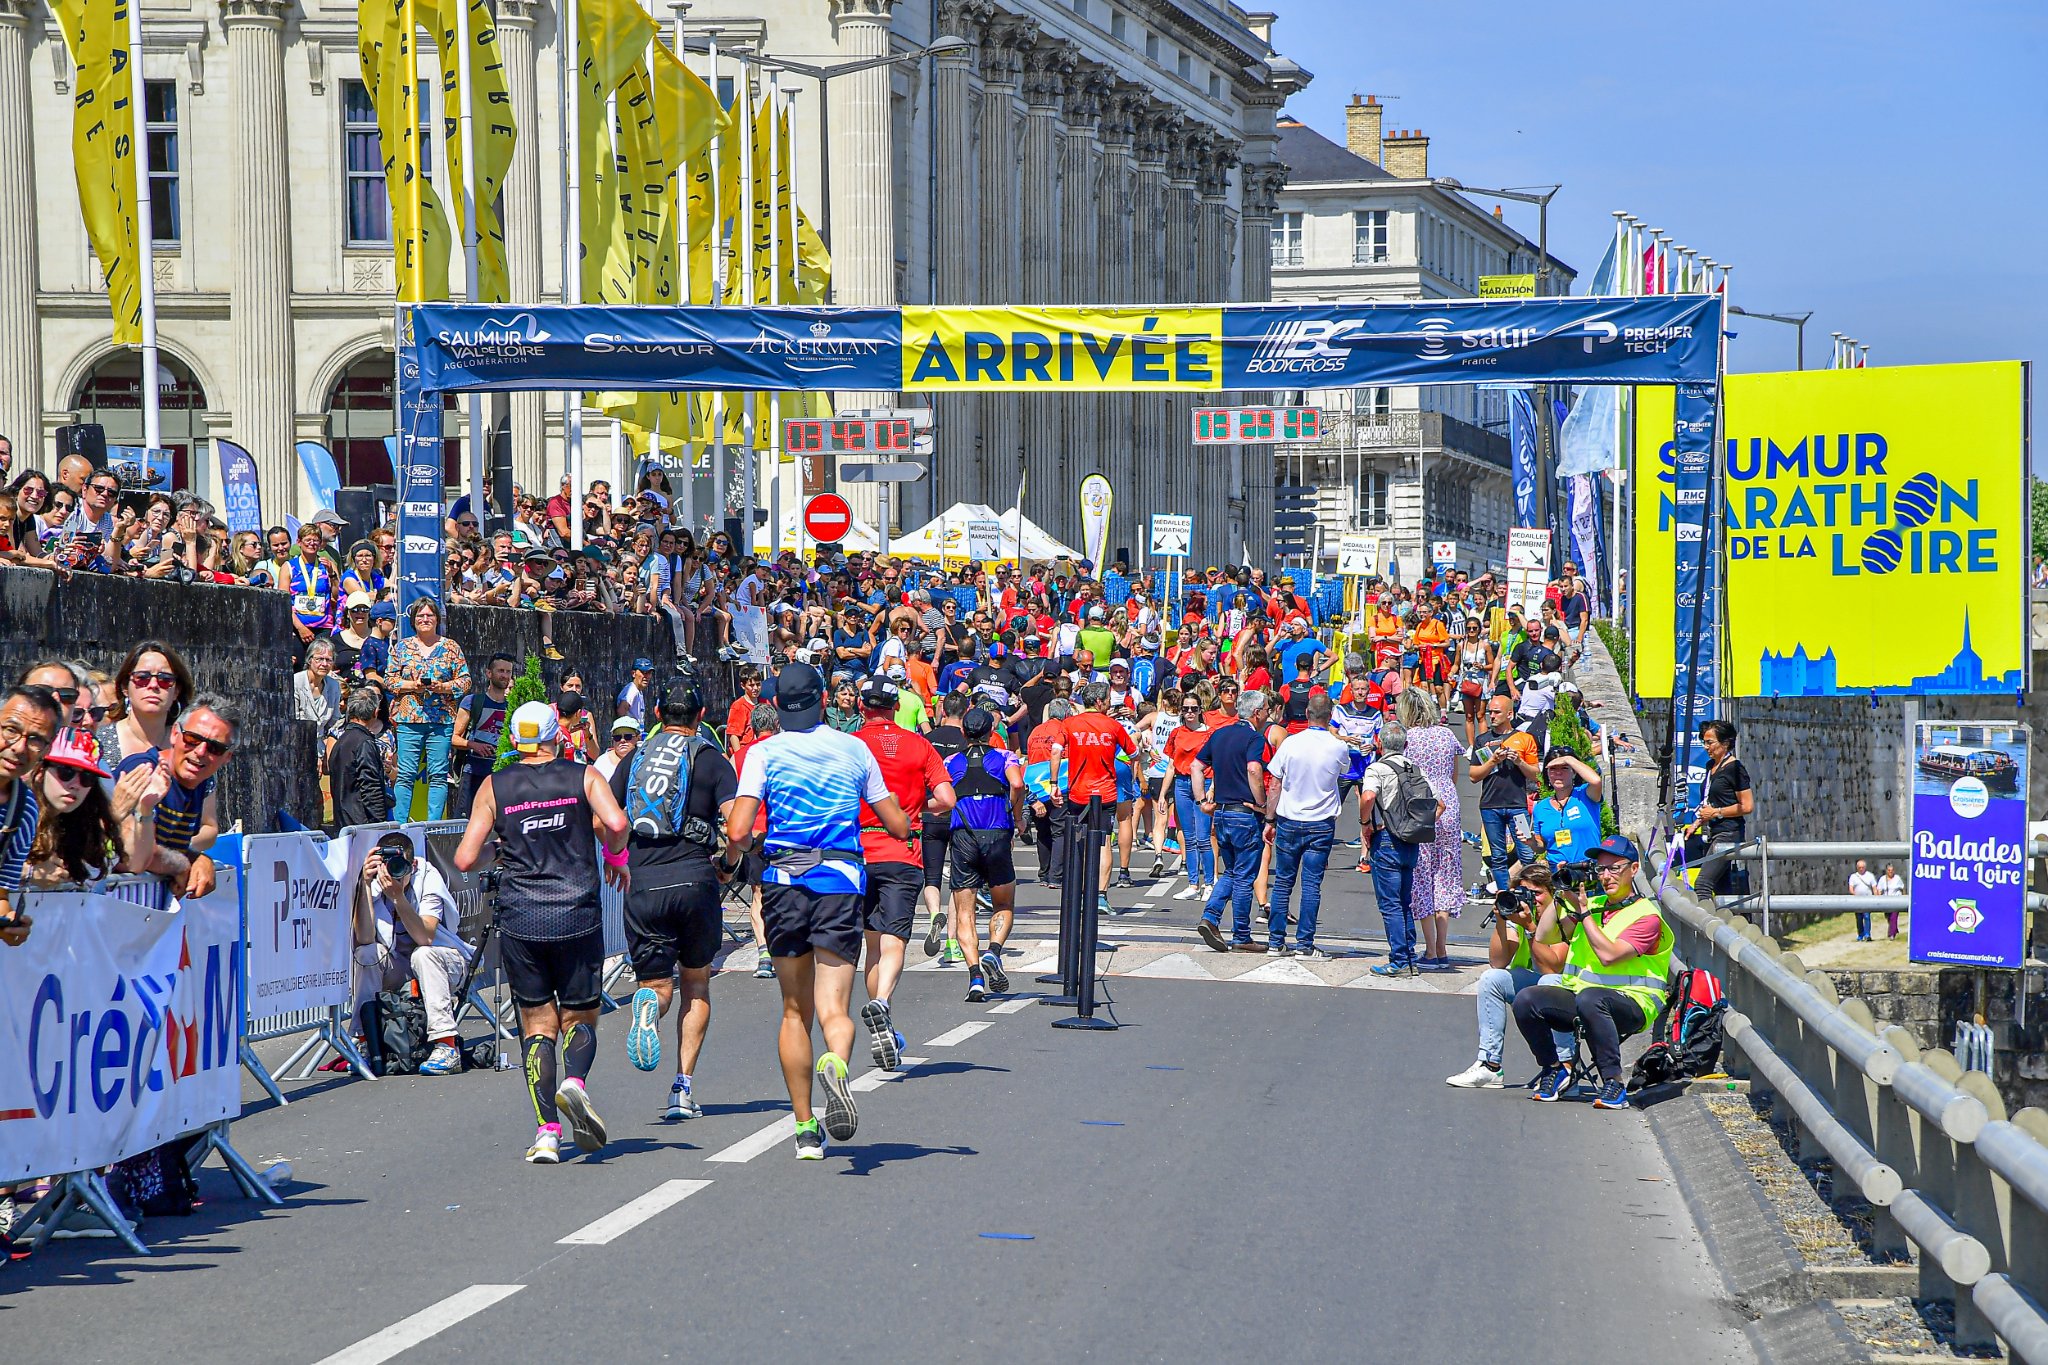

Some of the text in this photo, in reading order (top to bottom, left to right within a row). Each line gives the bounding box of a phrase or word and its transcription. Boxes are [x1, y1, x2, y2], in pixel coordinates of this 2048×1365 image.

[1480, 286, 1533, 294] MARATHON
[438, 330, 521, 347] SAUMUR
[746, 328, 878, 356] ACKERMAN
[1462, 327, 1536, 348] saur
[1624, 326, 1693, 342] PREMIER
[451, 346, 483, 359] VAL
[497, 345, 546, 357] LOIRE
[911, 317, 1213, 383] ARRIVÉE
[1624, 341, 1667, 354] TECH
[444, 357, 528, 370] AGGLOMÉRATION
[1245, 357, 1348, 373] BODYCROSS
[1462, 356, 1497, 366] France
[1657, 432, 1888, 484] SUMUR
[1684, 491, 1705, 500] RMC
[412, 504, 433, 512] RMC
[1679, 530, 1702, 539] SNC
[407, 542, 437, 551] SNCF
[1731, 535, 1817, 560] DE LA
[1073, 732, 1112, 747] YAC
[504, 797, 578, 815] Run&Freedom
[522, 813, 565, 834] poli
[1914, 830, 2023, 865] Balades
[1915, 861, 2021, 889] sur la Loire
